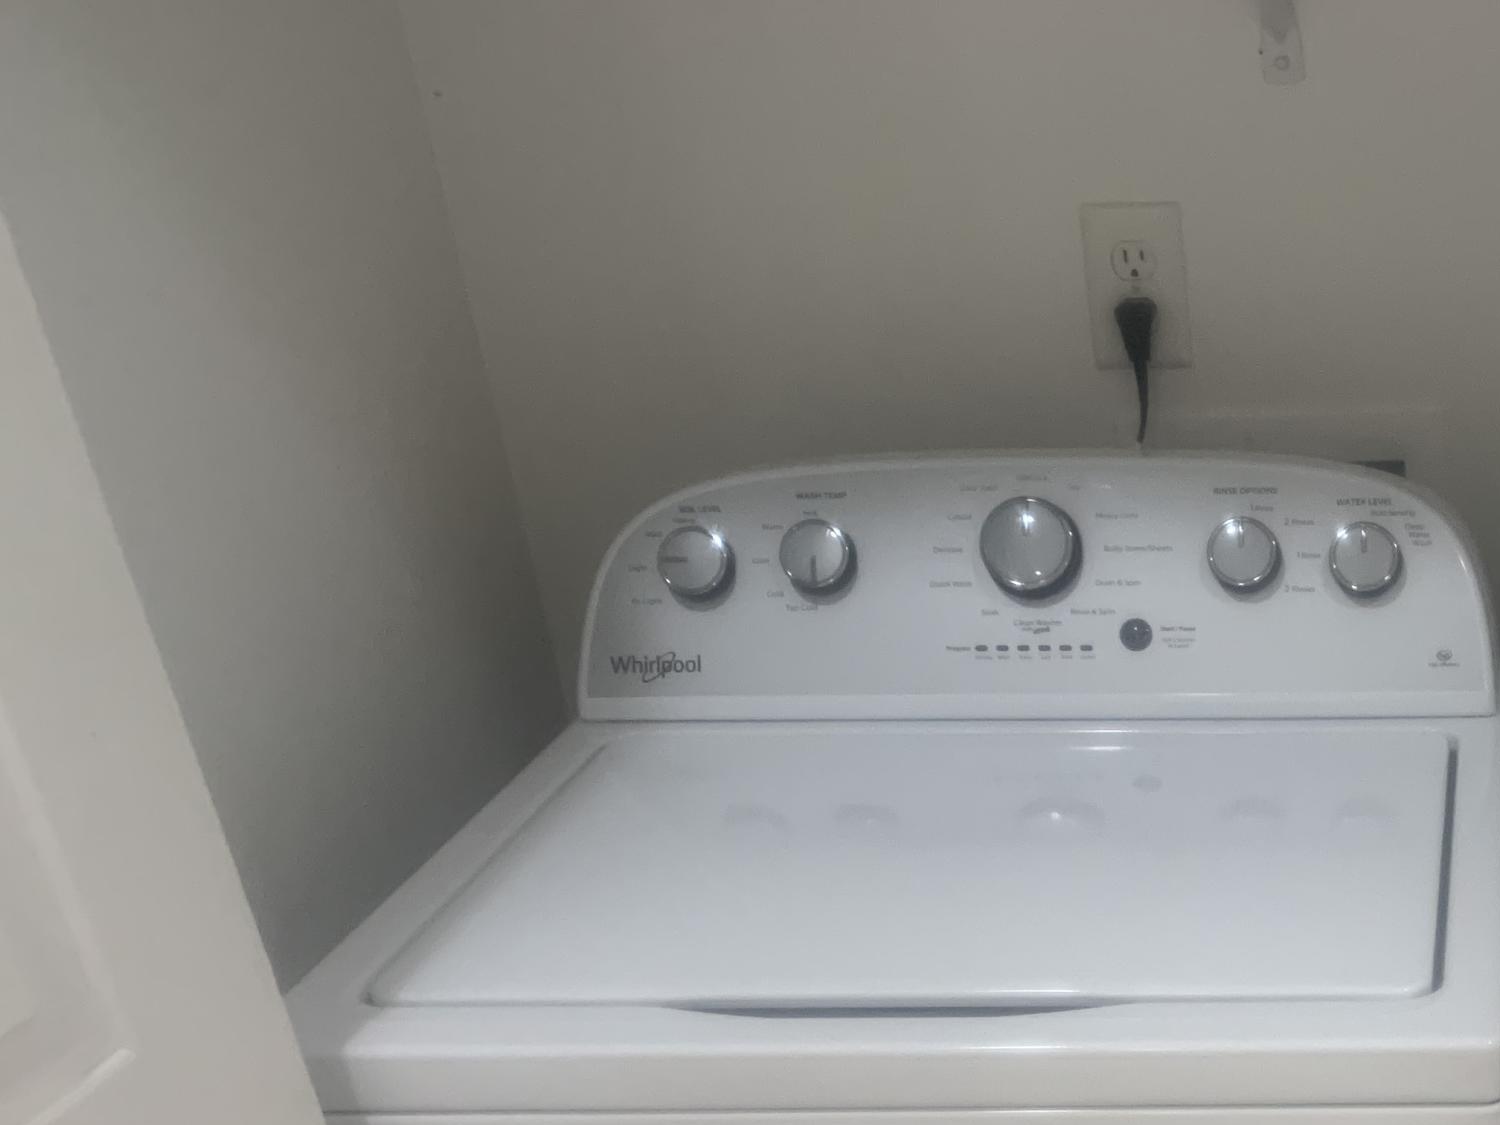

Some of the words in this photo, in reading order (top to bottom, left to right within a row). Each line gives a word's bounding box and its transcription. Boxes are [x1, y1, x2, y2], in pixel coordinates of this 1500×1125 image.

[1336, 497, 1366, 506] WATER
[1367, 497, 1392, 506] LEVEL
[610, 653, 702, 681] Whirlpool
